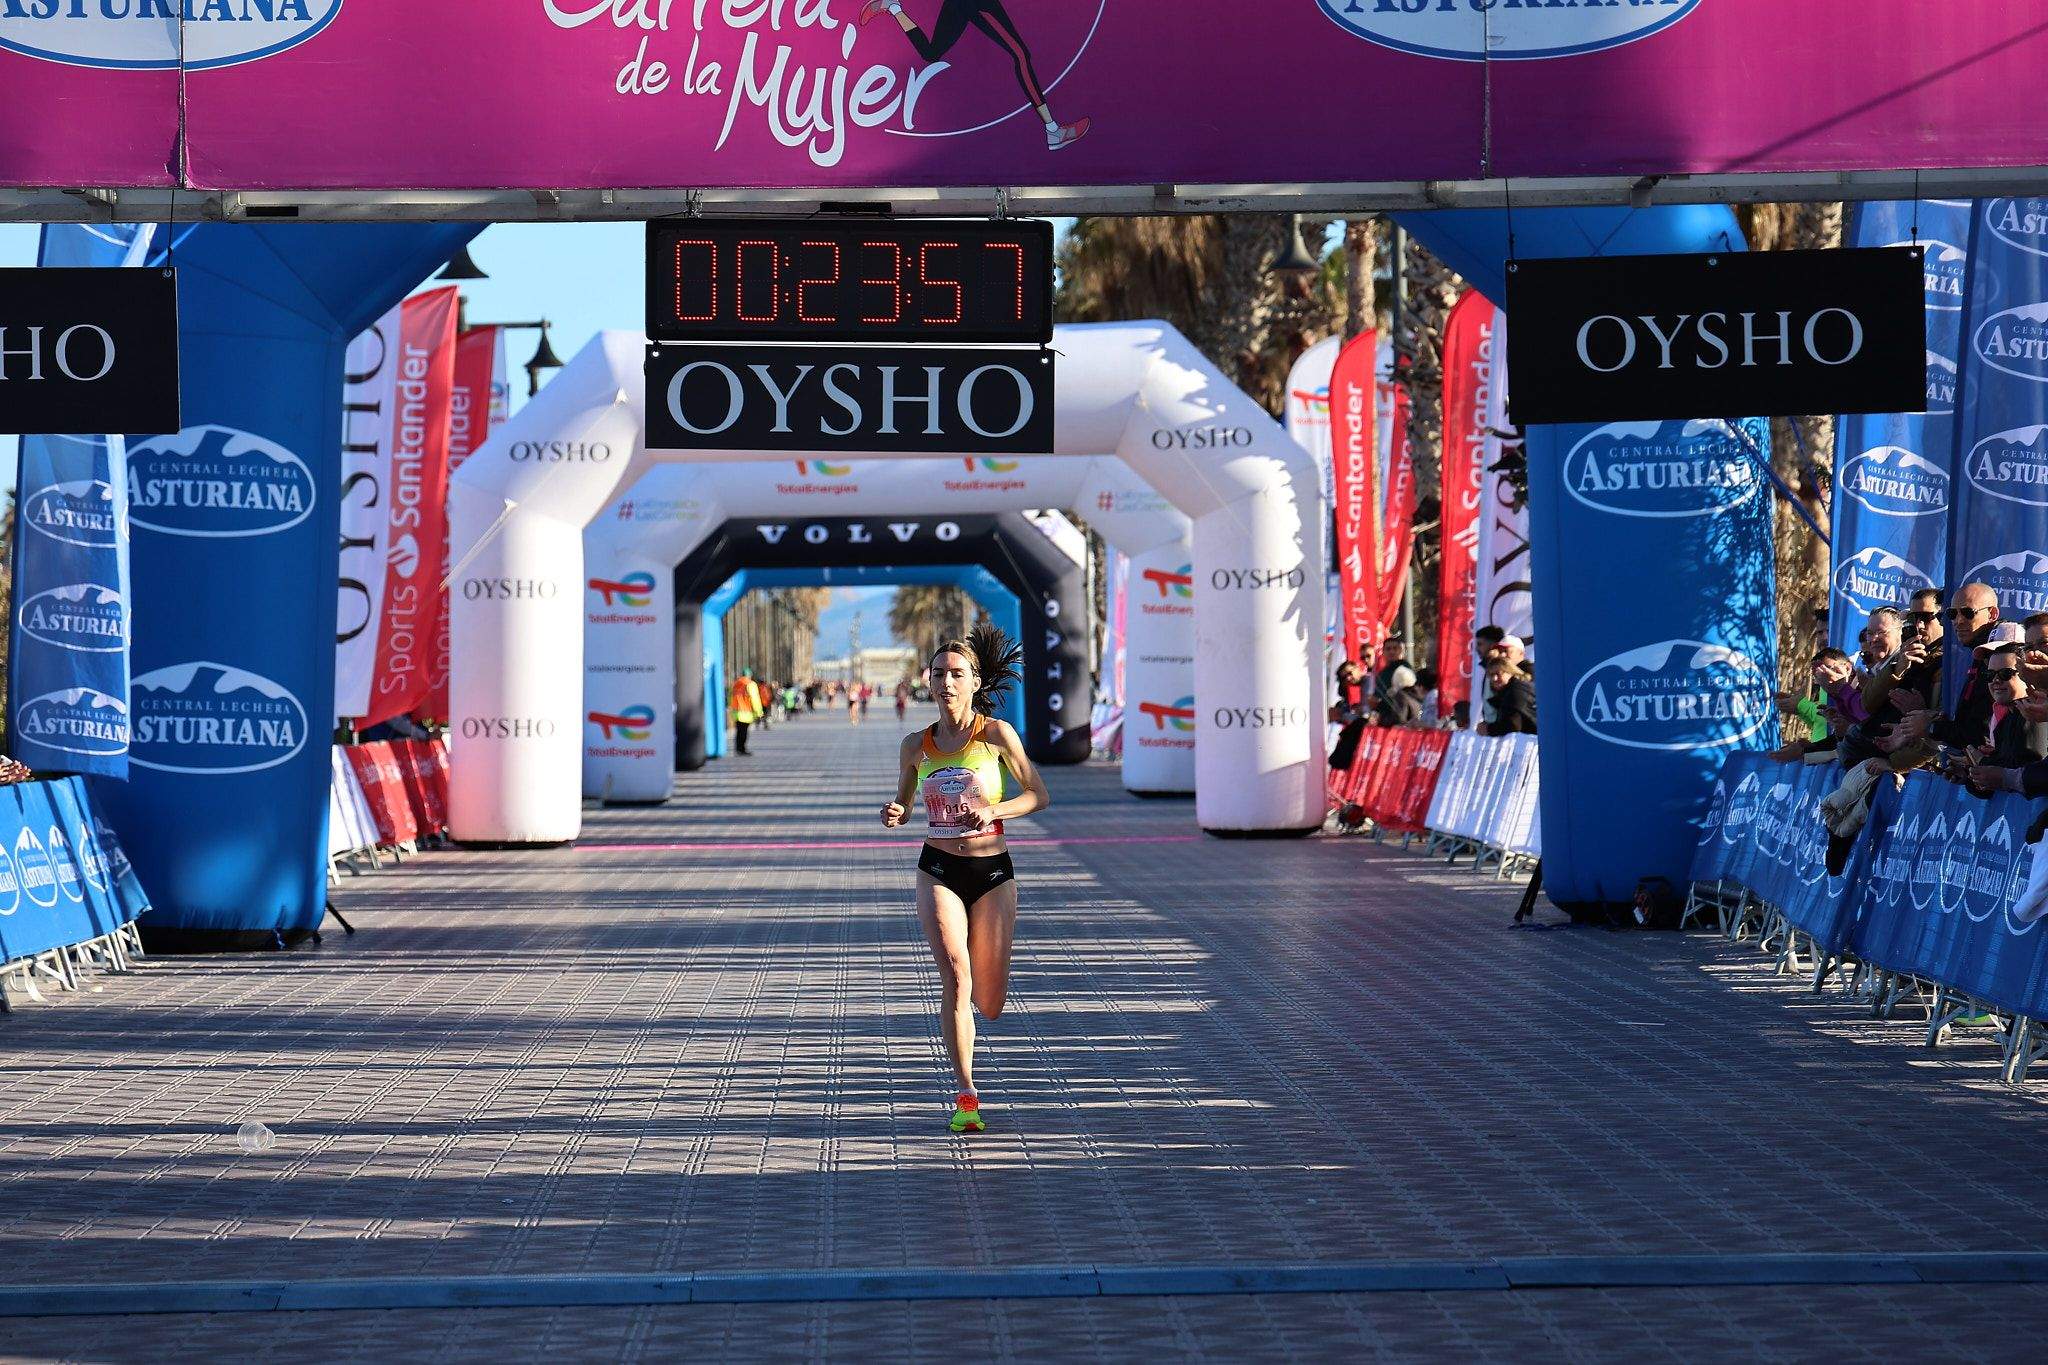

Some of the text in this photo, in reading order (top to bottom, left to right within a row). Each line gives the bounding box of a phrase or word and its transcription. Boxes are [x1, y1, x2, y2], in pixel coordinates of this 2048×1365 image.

[616, 22, 951, 168] de la Mujer
[1576, 308, 1863, 372] OYSHO
[666, 361, 1034, 438] OYSHO
[1152, 428, 1253, 450] OYSHO
[509, 442, 610, 464] OYSHO
[1609, 446, 1682, 457] CENTRAL
[149, 462, 299, 479] CENTRAL LECHERA
[126, 465, 303, 512] ASTURIANA
[776, 483, 859, 497] TotalEnergies
[944, 480, 1026, 493] TotalEnergies
[380, 343, 430, 694] Sports Santander
[756, 522, 961, 545] VOLVO
[463, 578, 557, 601] OYSHO
[1212, 568, 1305, 590] OYSHO
[1045, 599, 1064, 744] VOLVO
[1617, 678, 1691, 690] CENTRAL
[141, 700, 291, 714] CENTRAL LECHERA
[1586, 681, 1766, 723] ASTURIANA
[462, 717, 556, 740] OYSHO
[1214, 708, 1307, 729] OYSHO
